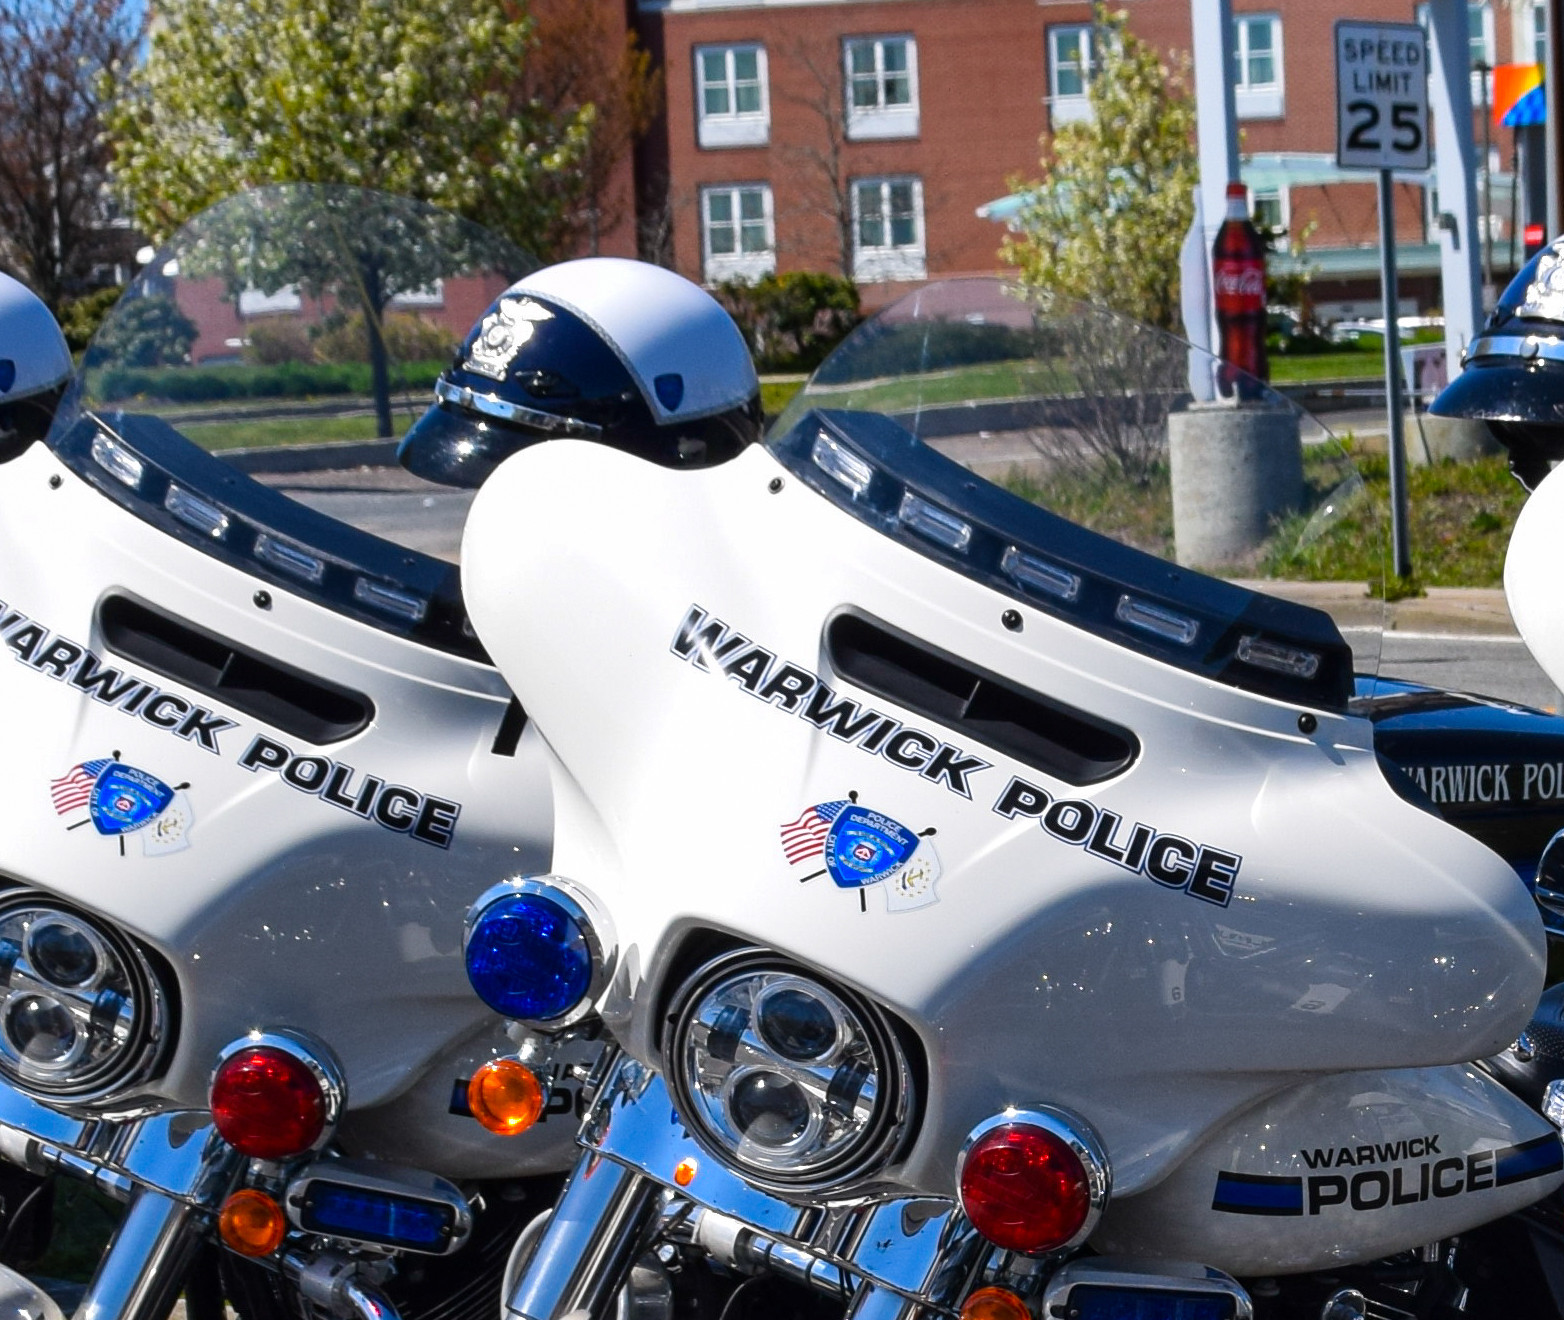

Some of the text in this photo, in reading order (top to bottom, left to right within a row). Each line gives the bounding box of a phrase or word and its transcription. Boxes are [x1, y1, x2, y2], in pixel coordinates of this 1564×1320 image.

[1344, 38, 1420, 65] SPEED
[1353, 70, 1412, 95] LIMIT
[1346, 102, 1422, 153] 25
[669, 604, 1242, 907] WARWICK POLICE
[238, 734, 461, 849] POLICE
[1401, 764, 1510, 803] ARWICK
[850, 814, 909, 845] DEPARTMENT
[867, 812, 903, 832] POLICE
[827, 834, 838, 853] CITY
[860, 860, 905, 885] WARWICK
[1301, 1135, 1441, 1169] WARWICK
[1307, 1150, 1495, 1216] POLICE
